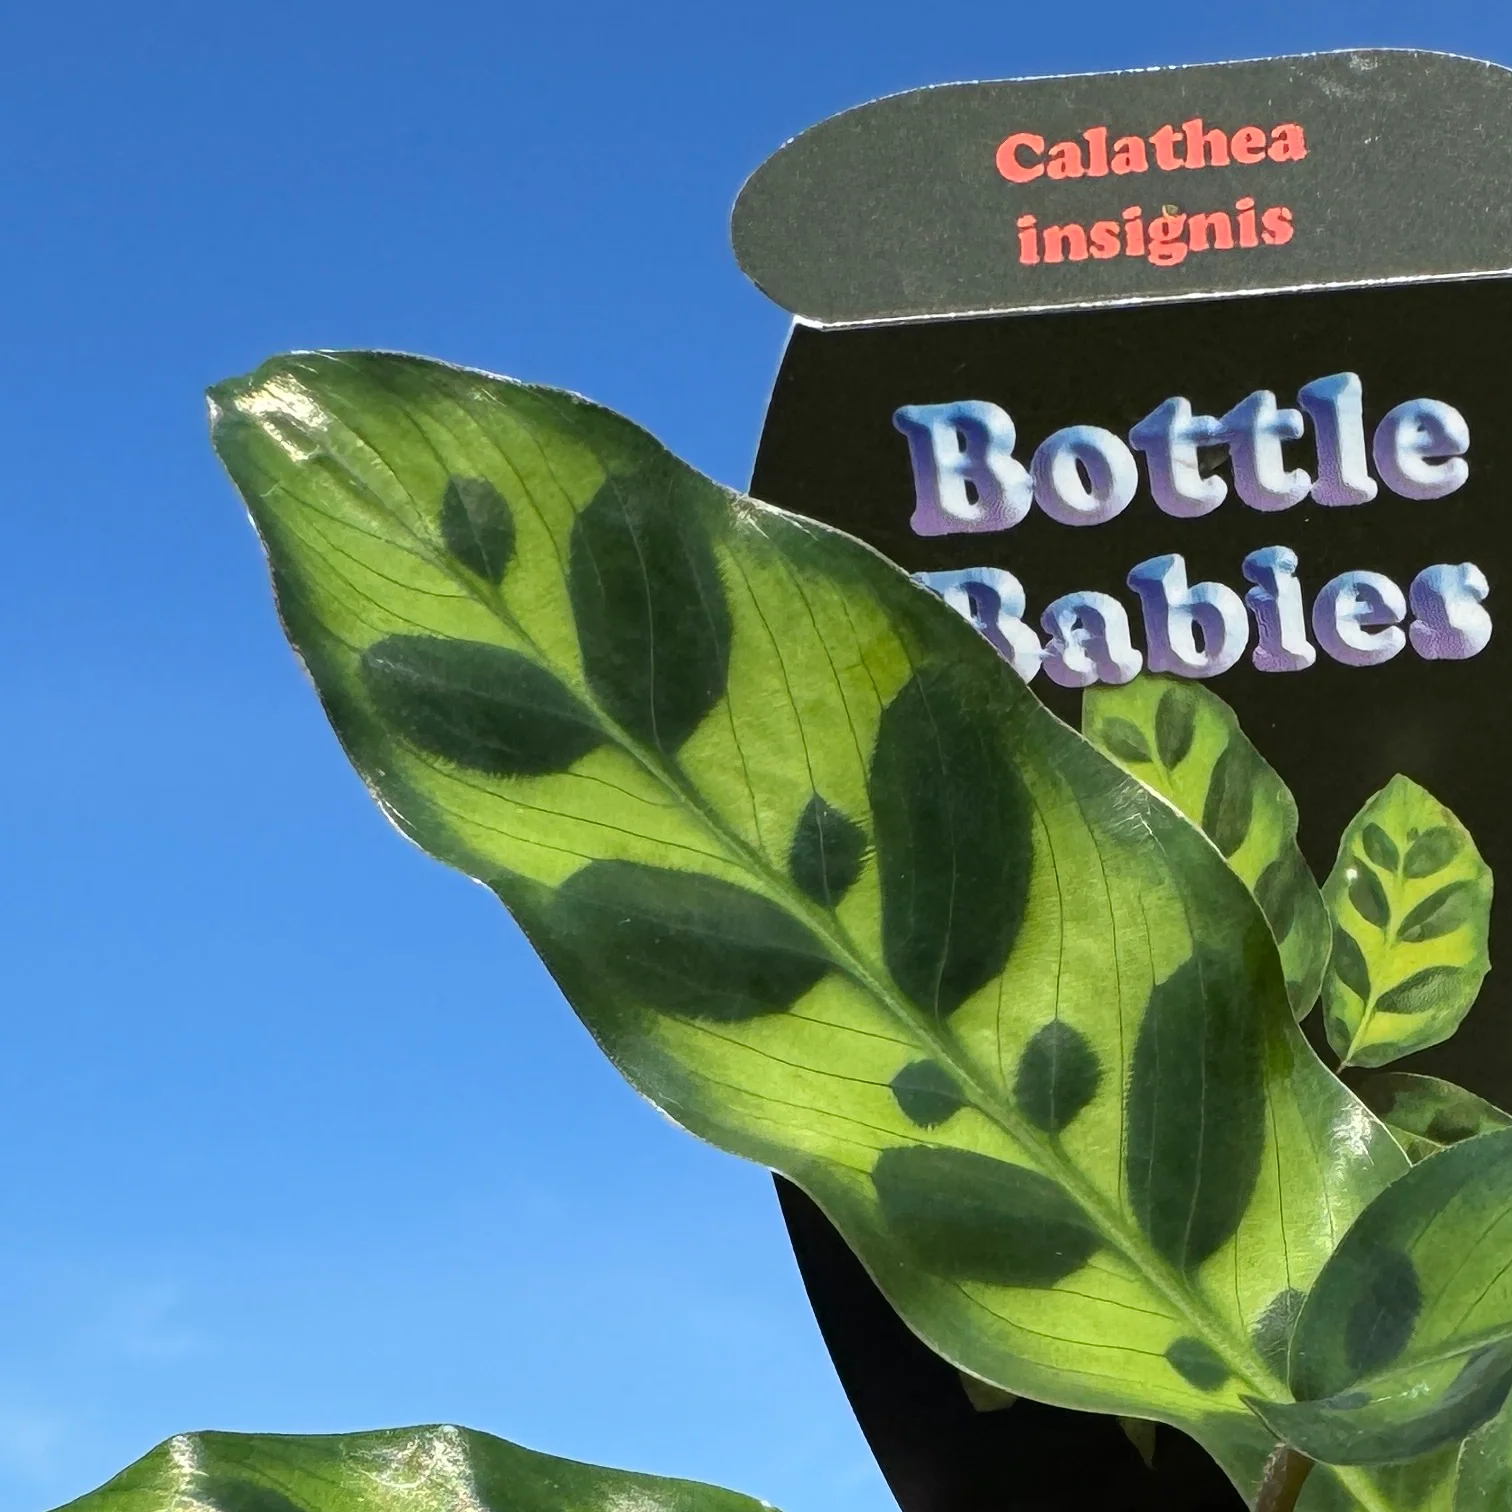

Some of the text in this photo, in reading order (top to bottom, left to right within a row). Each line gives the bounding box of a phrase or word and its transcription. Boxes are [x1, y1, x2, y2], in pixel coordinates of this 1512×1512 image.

[996, 118, 1307, 184] Calathea
[1017, 197, 1295, 267] insignis
[893, 371, 1471, 537] Bottle
[910, 545, 1494, 688] Babies
